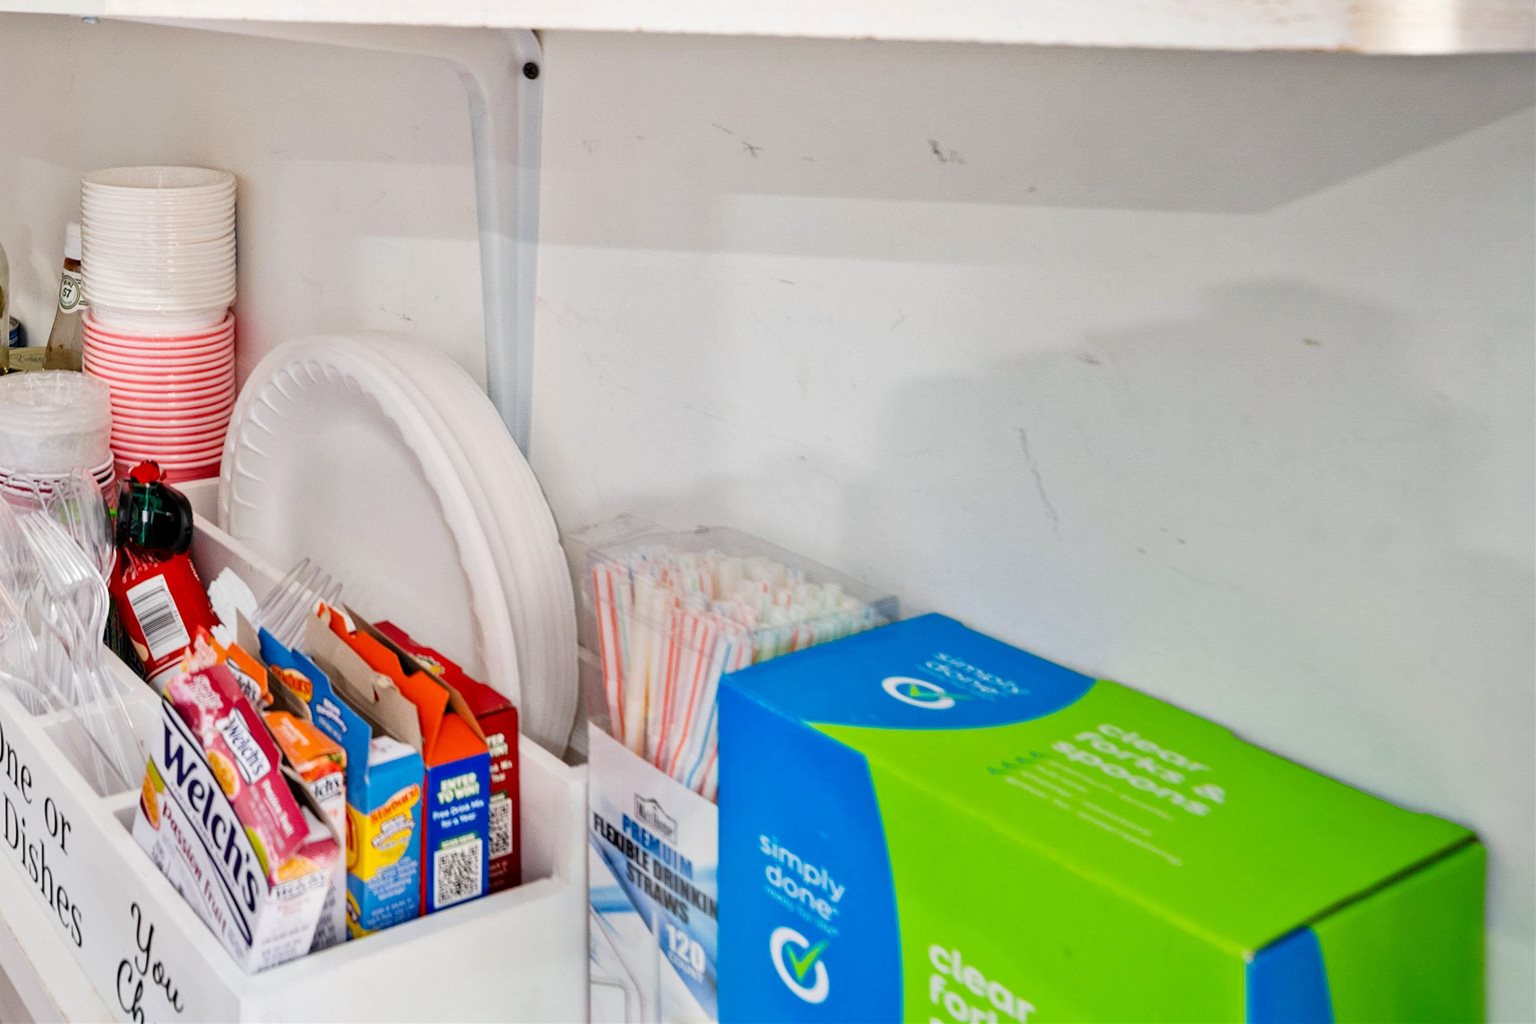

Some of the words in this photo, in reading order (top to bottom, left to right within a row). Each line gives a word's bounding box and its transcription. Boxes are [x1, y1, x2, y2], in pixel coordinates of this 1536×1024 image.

[925, 660, 1000, 695] done
[933, 652, 1022, 695] simply
[226, 716, 265, 778] Welch's
[1074, 731, 1186, 785] forks
[1191, 783, 1226, 805] &
[1097, 723, 1212, 773] clear
[437, 788, 454, 805] TO
[455, 781, 480, 800] WIN!
[440, 772, 477, 791] ENTER
[1051, 740, 1212, 817] spoons
[43, 797, 72, 856] or
[163, 728, 258, 914] Welch's
[432, 809, 450, 821] Free
[450, 803, 470, 816] Drink
[470, 799, 484, 809] Mix
[3, 792, 84, 949] Dishes
[592, 811, 650, 871] FLEXIBLE
[758, 833, 846, 903] simply
[625, 860, 691, 925] STRAWS
[765, 864, 833, 922] done
[131, 902, 185, 1013] You
[666, 923, 706, 975] 120
[927, 944, 1038, 1024] clear
